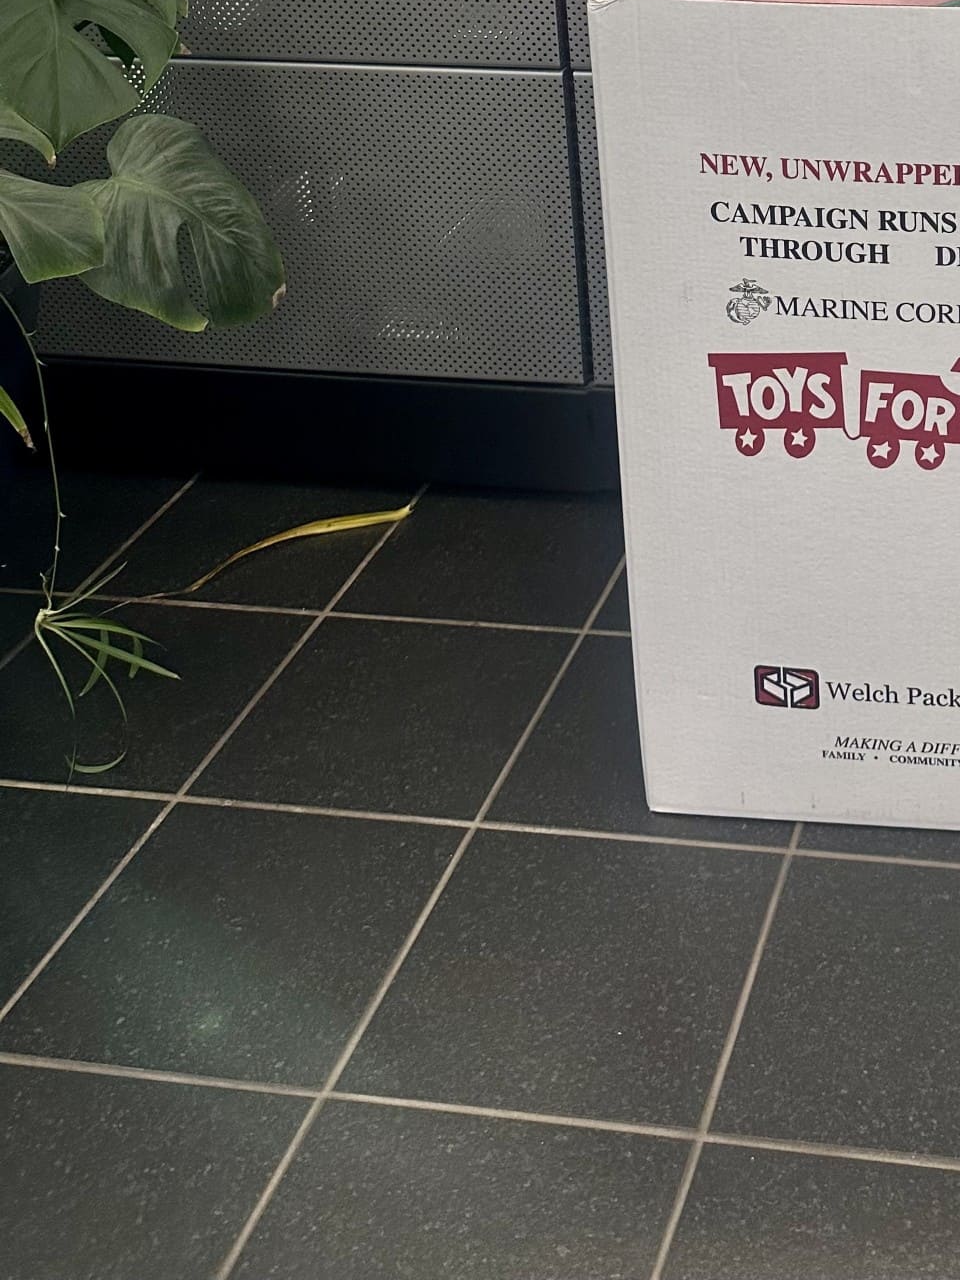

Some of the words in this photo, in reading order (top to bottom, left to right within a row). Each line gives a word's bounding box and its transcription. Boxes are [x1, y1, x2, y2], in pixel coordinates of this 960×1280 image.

[700, 153, 773, 182] NEW,
[710, 201, 869, 232] CAMPAIGN
[878, 210, 957, 234] RUNS
[740, 237, 890, 265] THROUGH
[774, 296, 889, 322] MARINE
[722, 366, 837, 420] TOYS
[865, 382, 956, 436] FOR
[825, 681, 899, 704] Welch
[822, 750, 866, 761] FAMILY
[834, 735, 902, 752] MAKING
[905, 740, 917, 753] A
